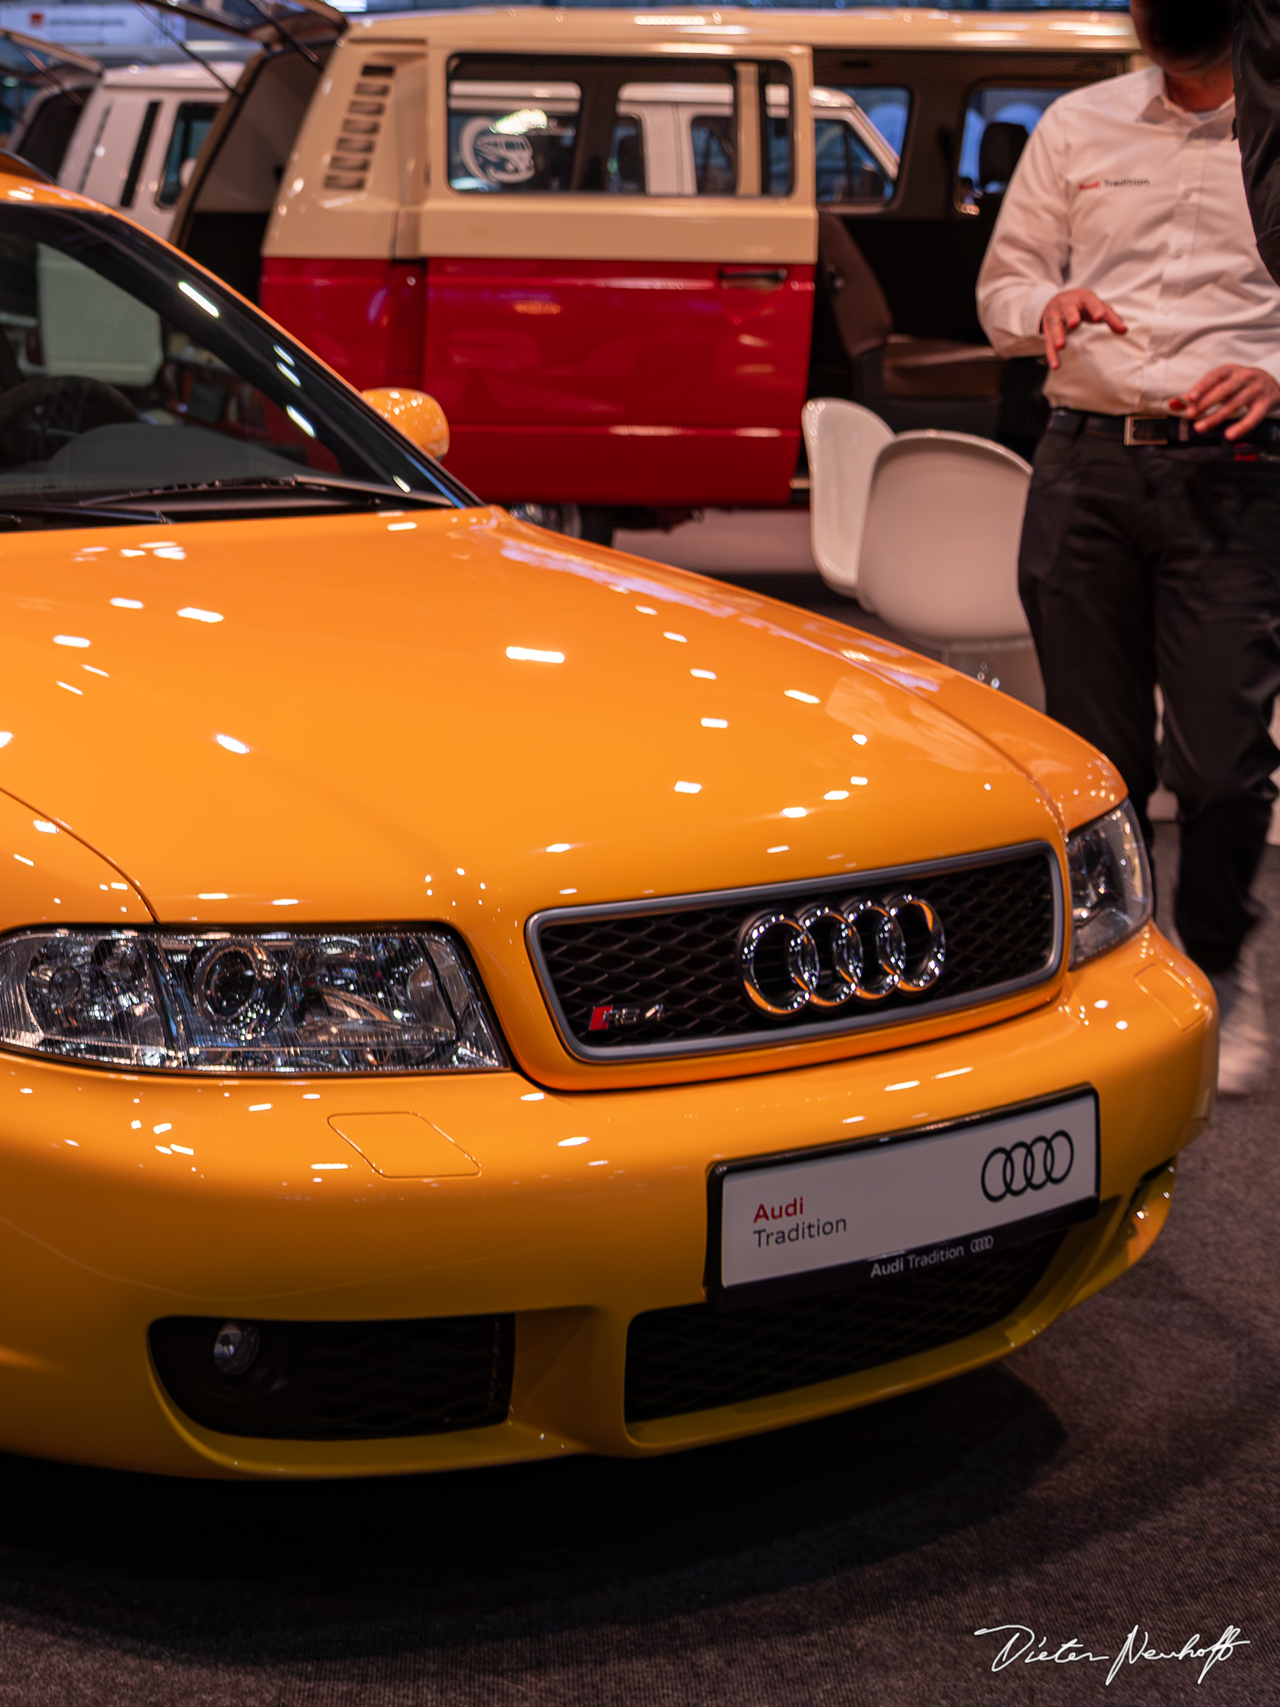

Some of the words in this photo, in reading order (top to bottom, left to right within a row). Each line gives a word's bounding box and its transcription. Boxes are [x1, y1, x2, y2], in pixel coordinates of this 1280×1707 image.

[1103, 178, 1150, 187] Tradition
[753, 1196, 804, 1224] Audi
[753, 1218, 847, 1248] Tradition
[870, 1257, 904, 1278] Audi
[907, 1245, 965, 1270] Tradition
